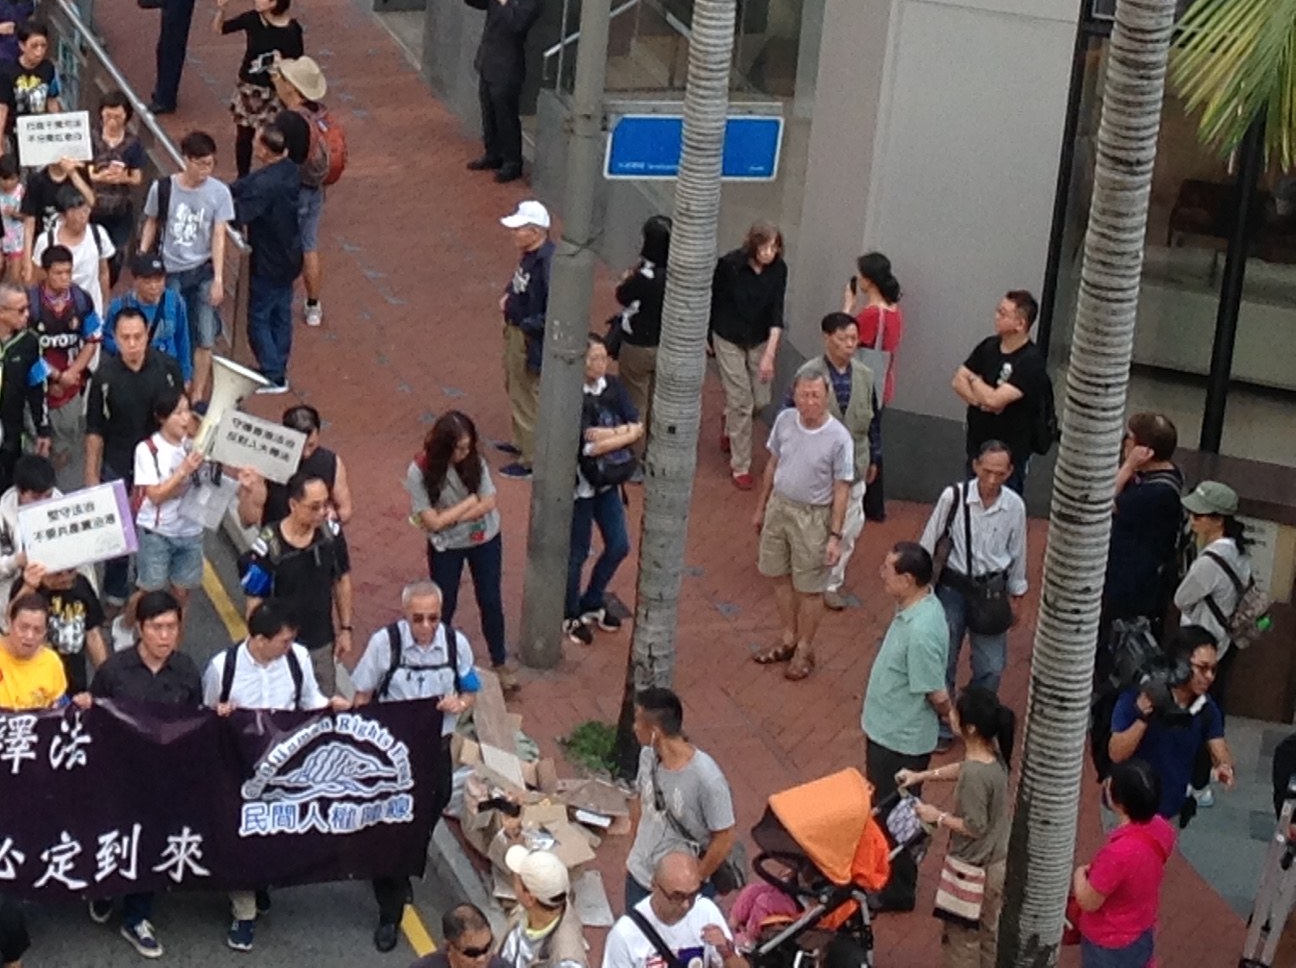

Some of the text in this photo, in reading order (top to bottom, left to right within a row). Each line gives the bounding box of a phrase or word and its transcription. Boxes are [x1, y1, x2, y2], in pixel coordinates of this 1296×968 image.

[226, 431, 291, 462] 反對人大釋法
[232, 417, 296, 449] 守護香港法治
[47, 502, 95, 522] 堅守法治
[33, 513, 116, 543] 不要共產黨治港
[273, 717, 333, 764] Human
[335, 713, 395, 750] Rights
[241, 796, 413, 836] 民間人權陣線
